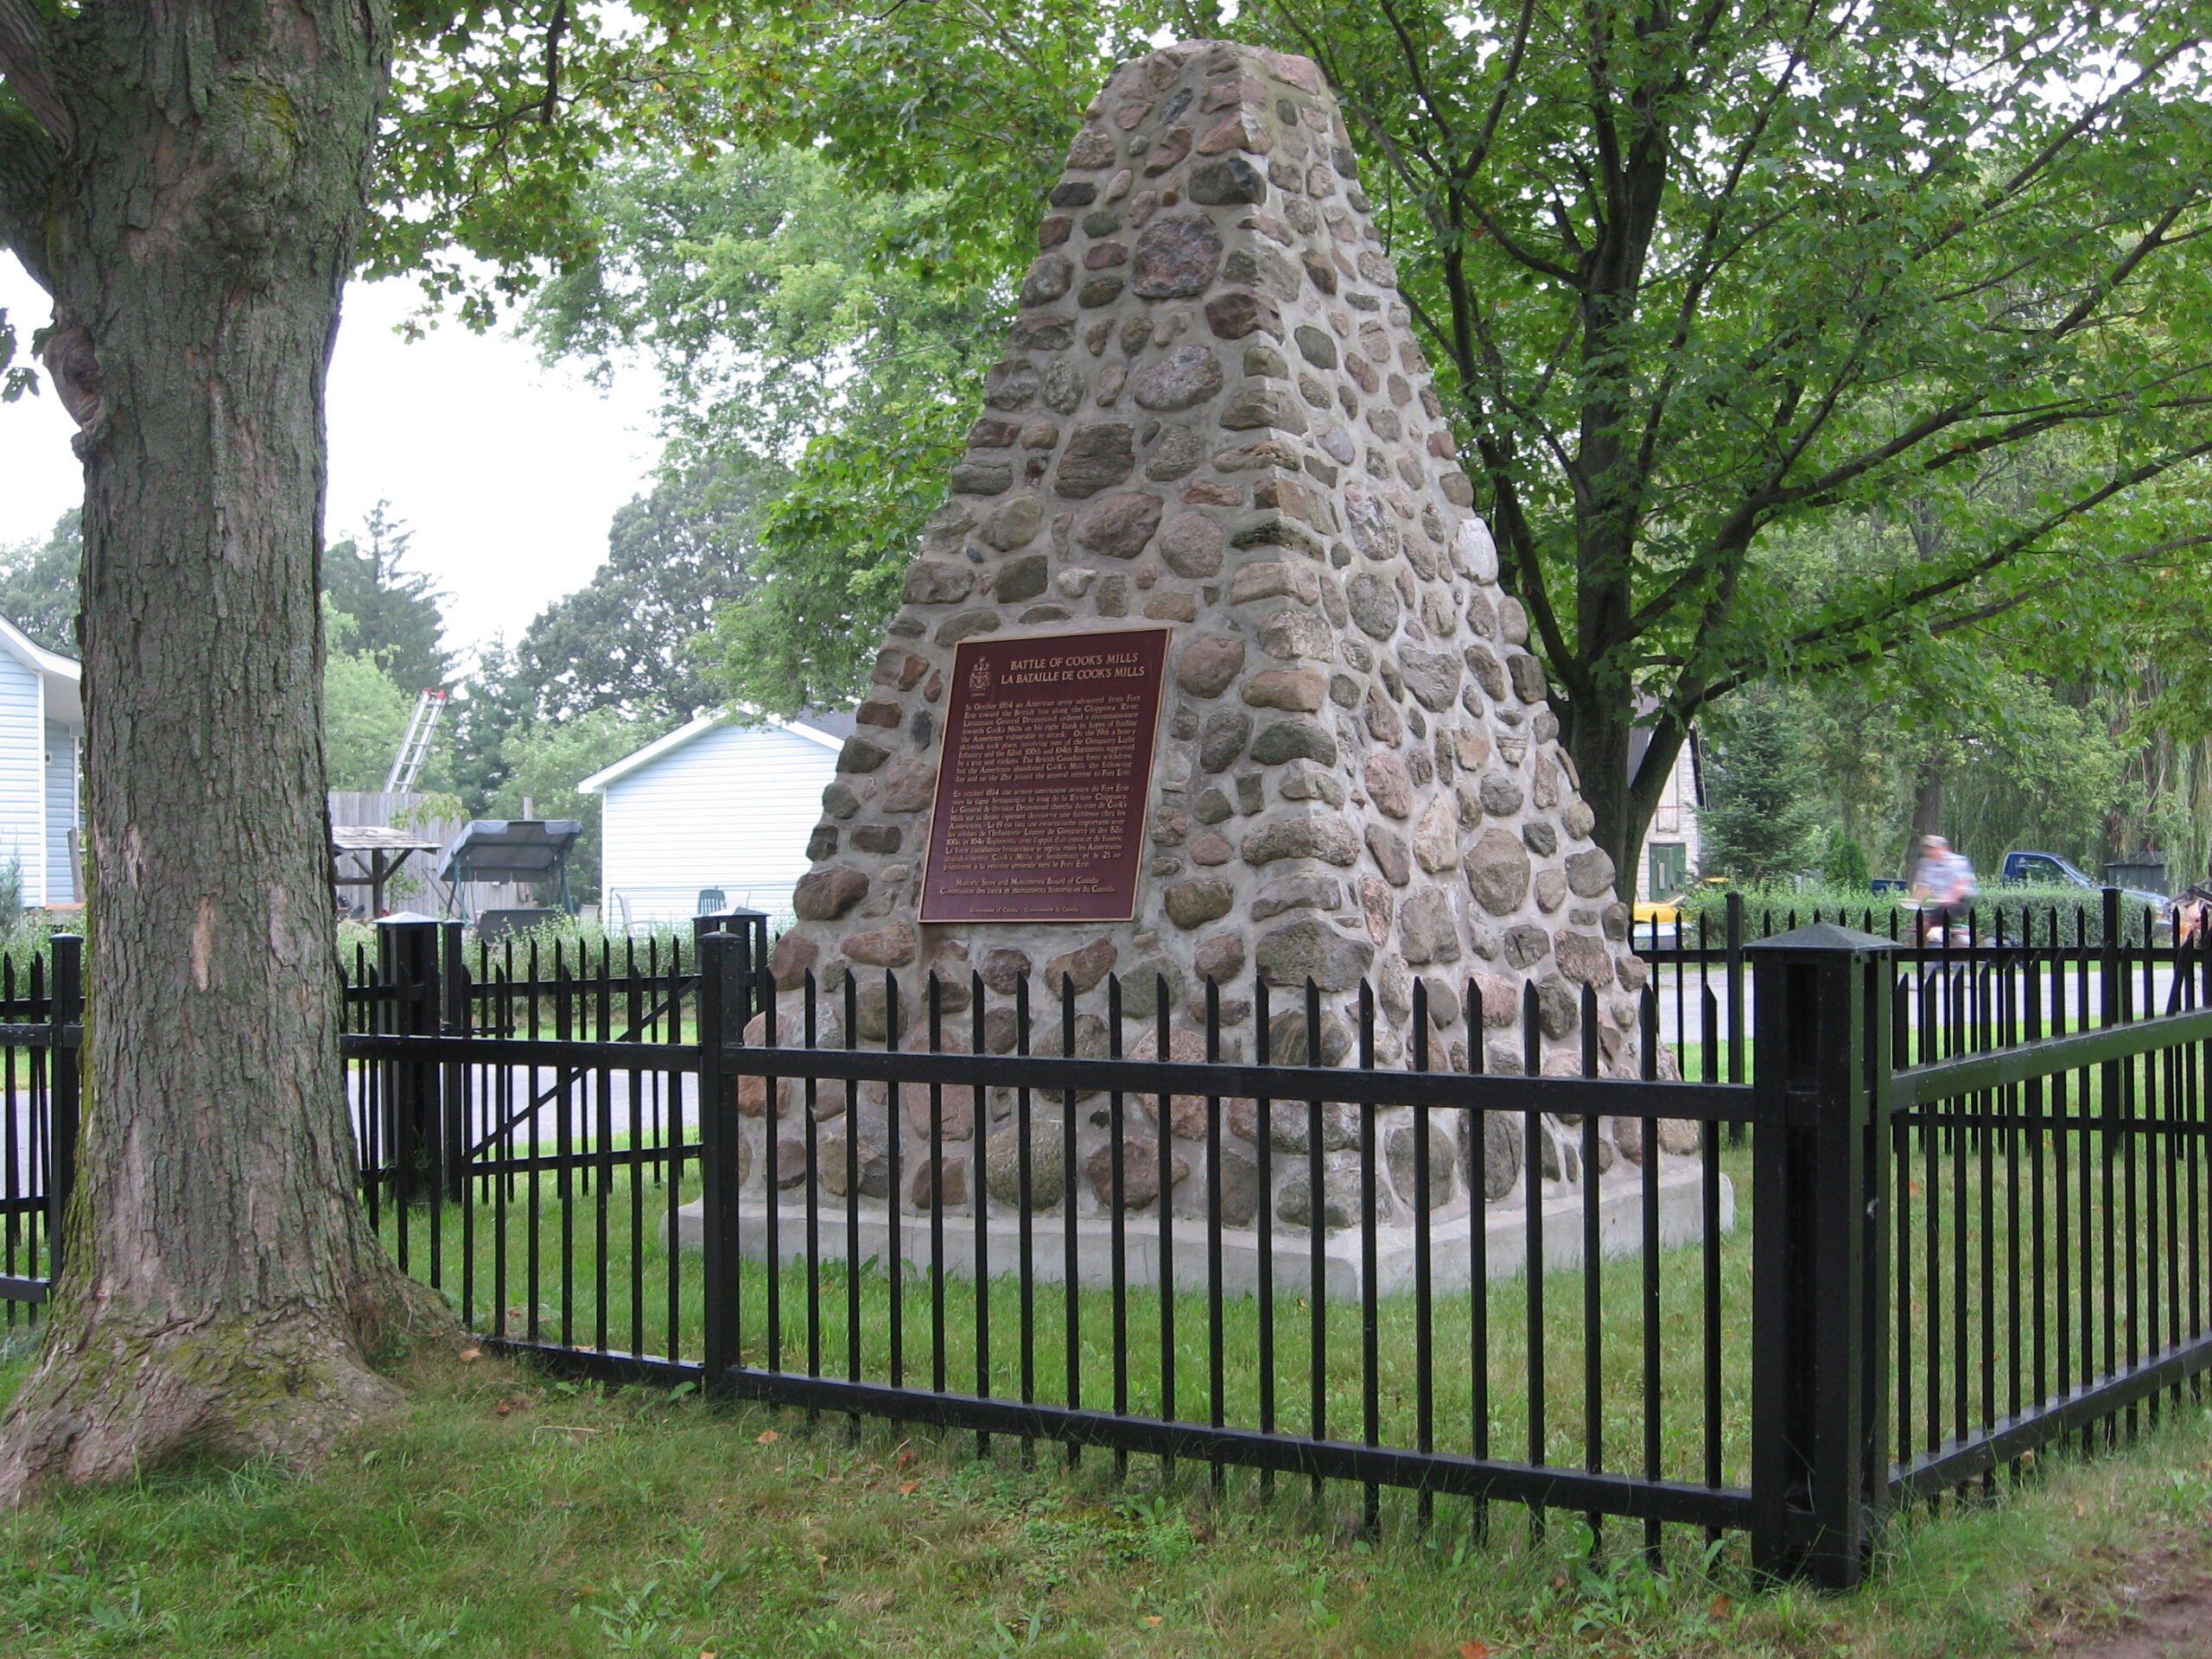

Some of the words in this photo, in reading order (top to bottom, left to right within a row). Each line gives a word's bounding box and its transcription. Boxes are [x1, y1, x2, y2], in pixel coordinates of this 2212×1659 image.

[1010, 658, 1047, 670] BATTLE
[1048, 658, 1063, 668] OF
[1065, 655, 1103, 667] COOK'S
[1106, 652, 1139, 664] MILLS
[1001, 674, 1014, 684] LA
[1016, 671, 1060, 683] BATAILLE
[1061, 671, 1075, 681] DE
[1077, 668, 1112, 680] COOK'S
[1114, 666, 1146, 677] MILLS
